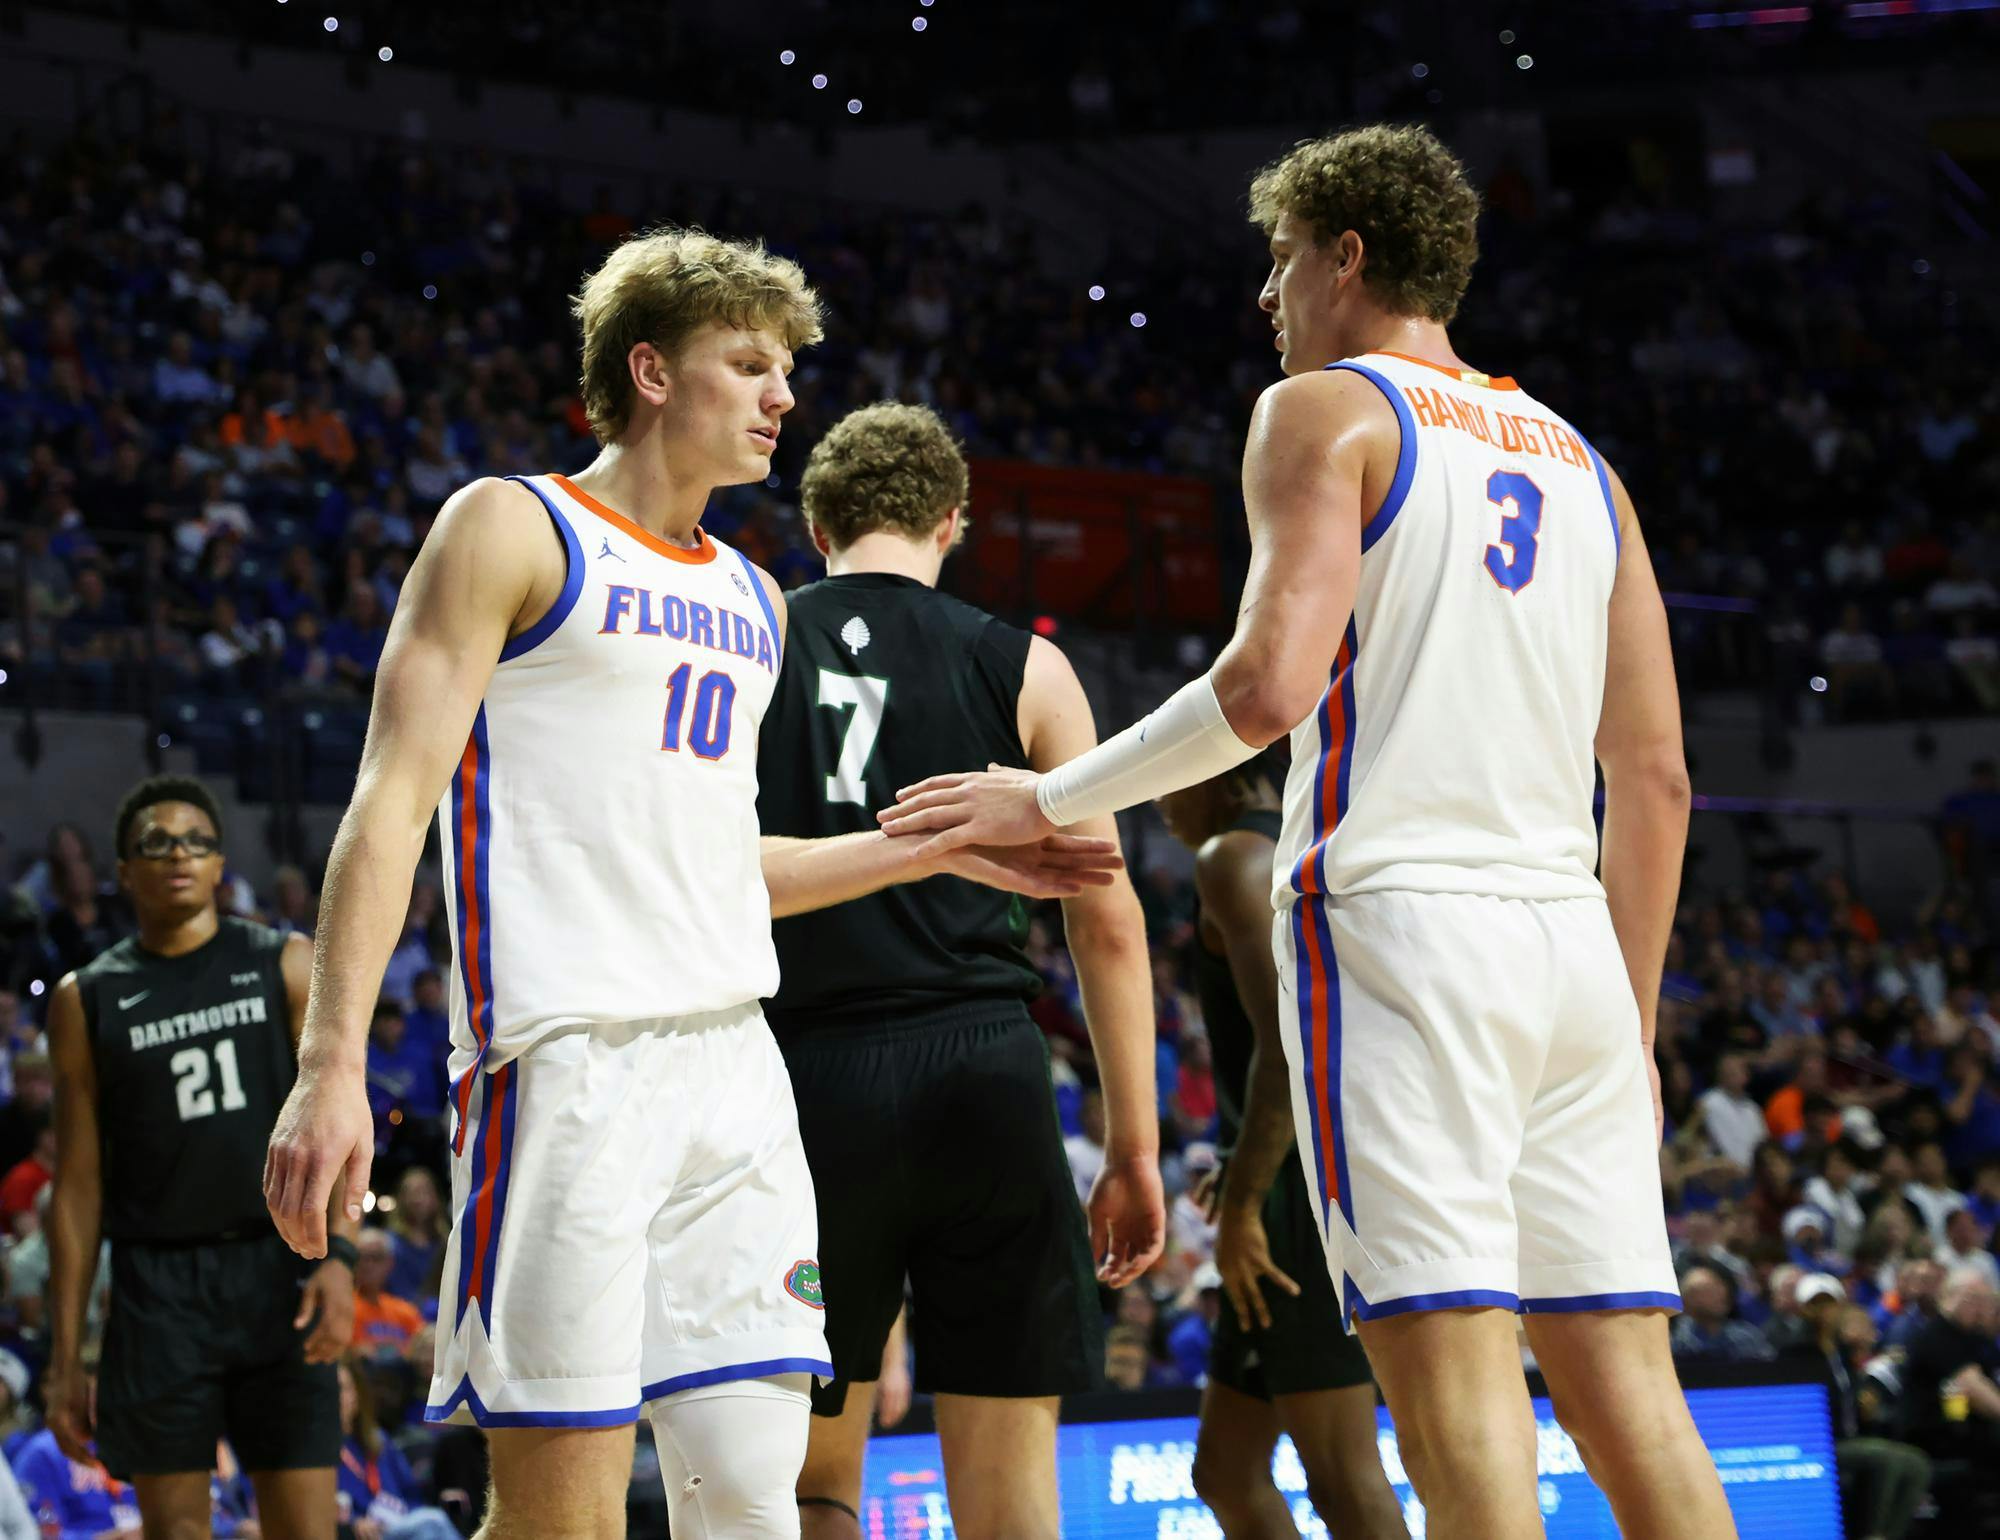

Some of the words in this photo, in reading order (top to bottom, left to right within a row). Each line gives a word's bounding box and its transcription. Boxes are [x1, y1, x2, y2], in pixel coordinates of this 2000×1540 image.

[1403, 386, 1592, 472] HANDLOGTEN
[1483, 468, 1544, 597] 3
[597, 583, 774, 676] FLORIDA
[661, 661, 737, 762] 10
[816, 666, 890, 809] 7
[128, 996, 268, 1052] DARTMOUTH
[170, 1038, 248, 1122] 21
